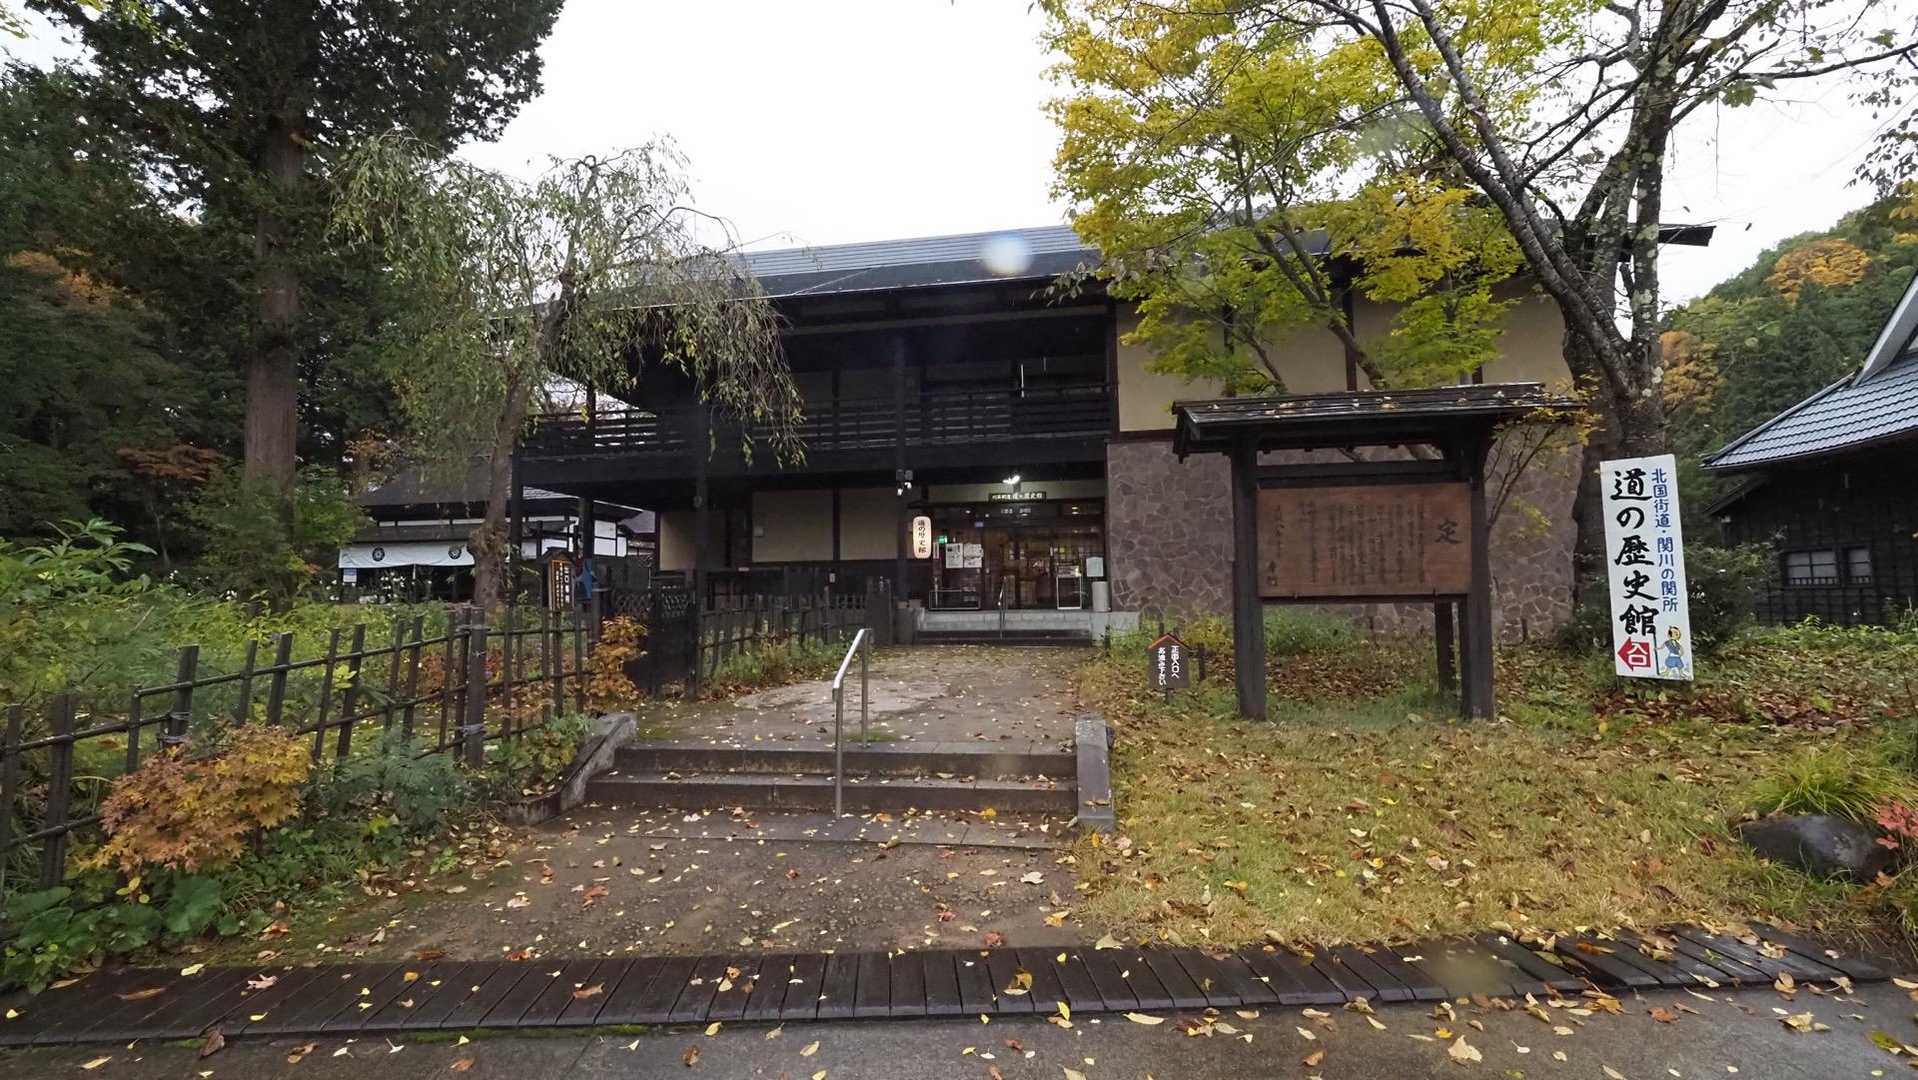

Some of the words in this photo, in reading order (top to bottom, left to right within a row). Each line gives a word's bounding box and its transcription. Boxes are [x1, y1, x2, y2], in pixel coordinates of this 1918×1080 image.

[1610, 468, 1659, 635] 道の歴史館
[1651, 468, 1678, 612] 北国街道・関川の関所
